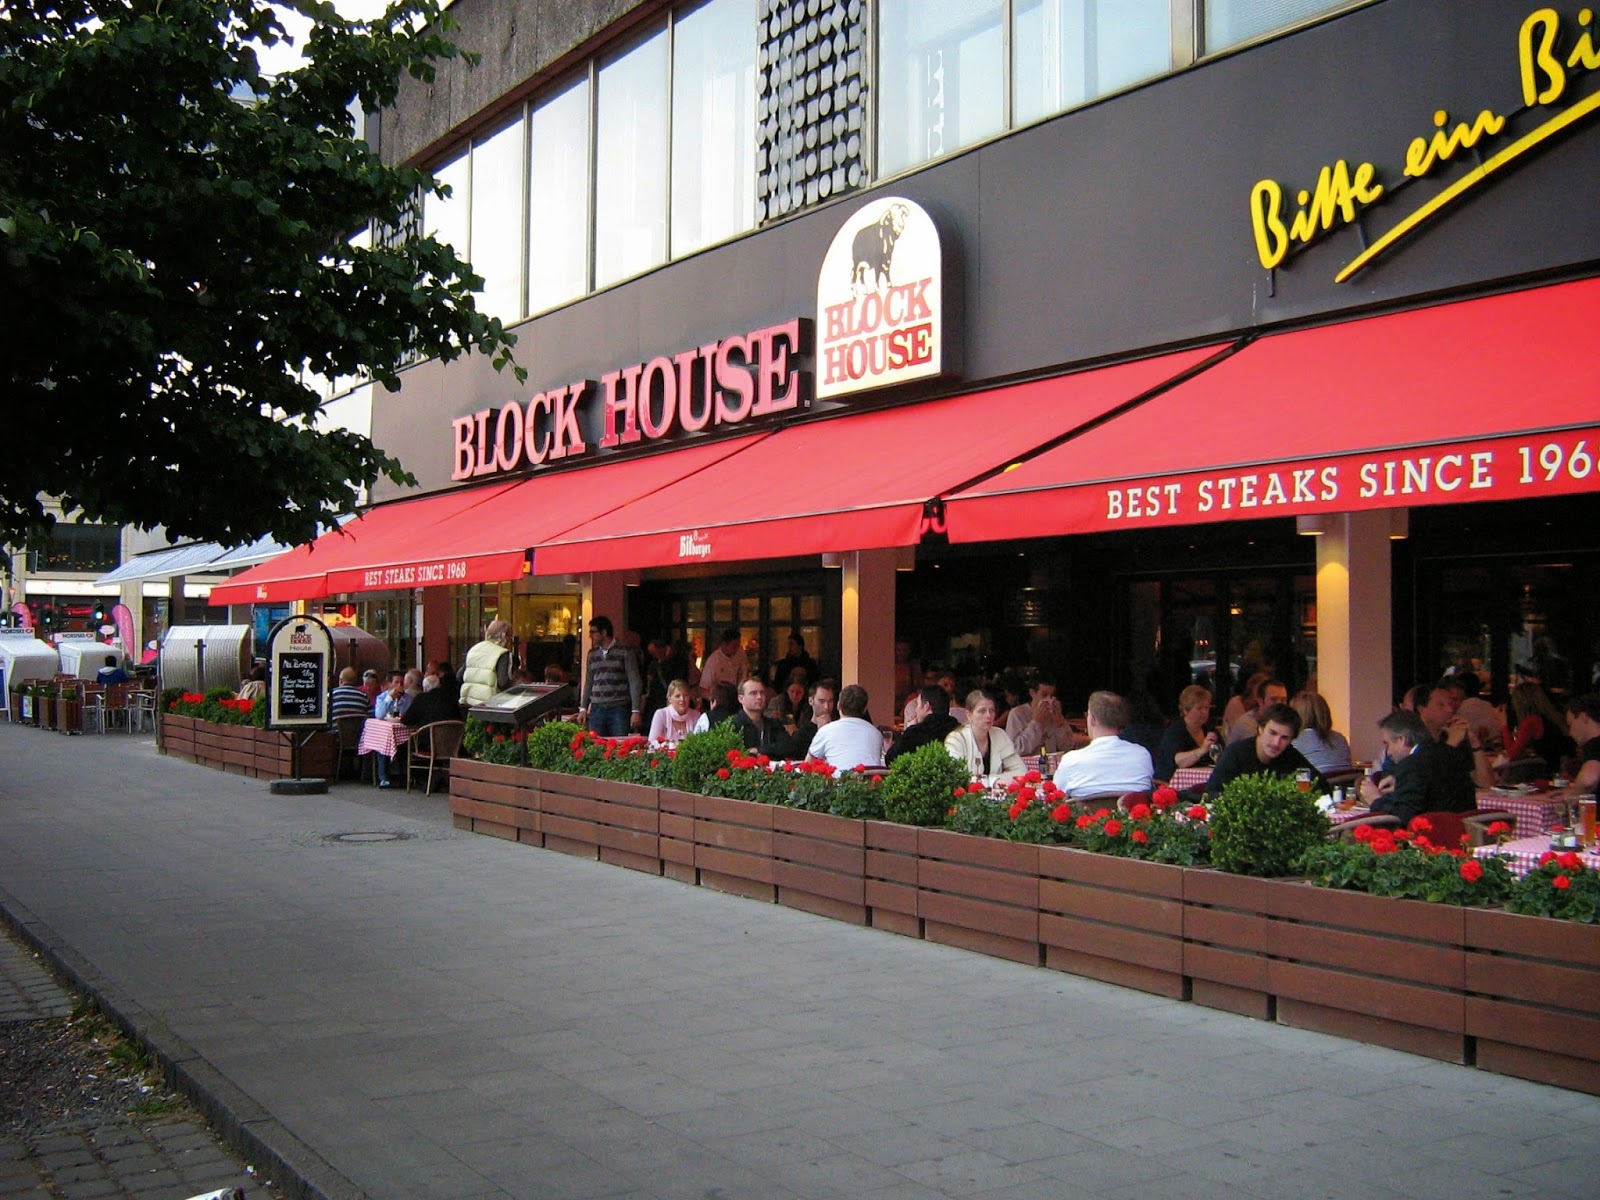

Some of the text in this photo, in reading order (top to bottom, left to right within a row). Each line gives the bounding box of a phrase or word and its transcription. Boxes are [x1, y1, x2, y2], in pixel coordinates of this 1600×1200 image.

[1250, 159, 1385, 271] Bitte
[1403, 110, 1506, 177] ein
[824, 277, 933, 344] BLOCK
[823, 322, 933, 386] HOUSE
[450, 318, 802, 482] BLOCK HOUSE
[1106, 440, 1600, 520] BEST STEAKS SINCE 196
[364, 561, 467, 587] BEST STEAKS SINCE 1968
